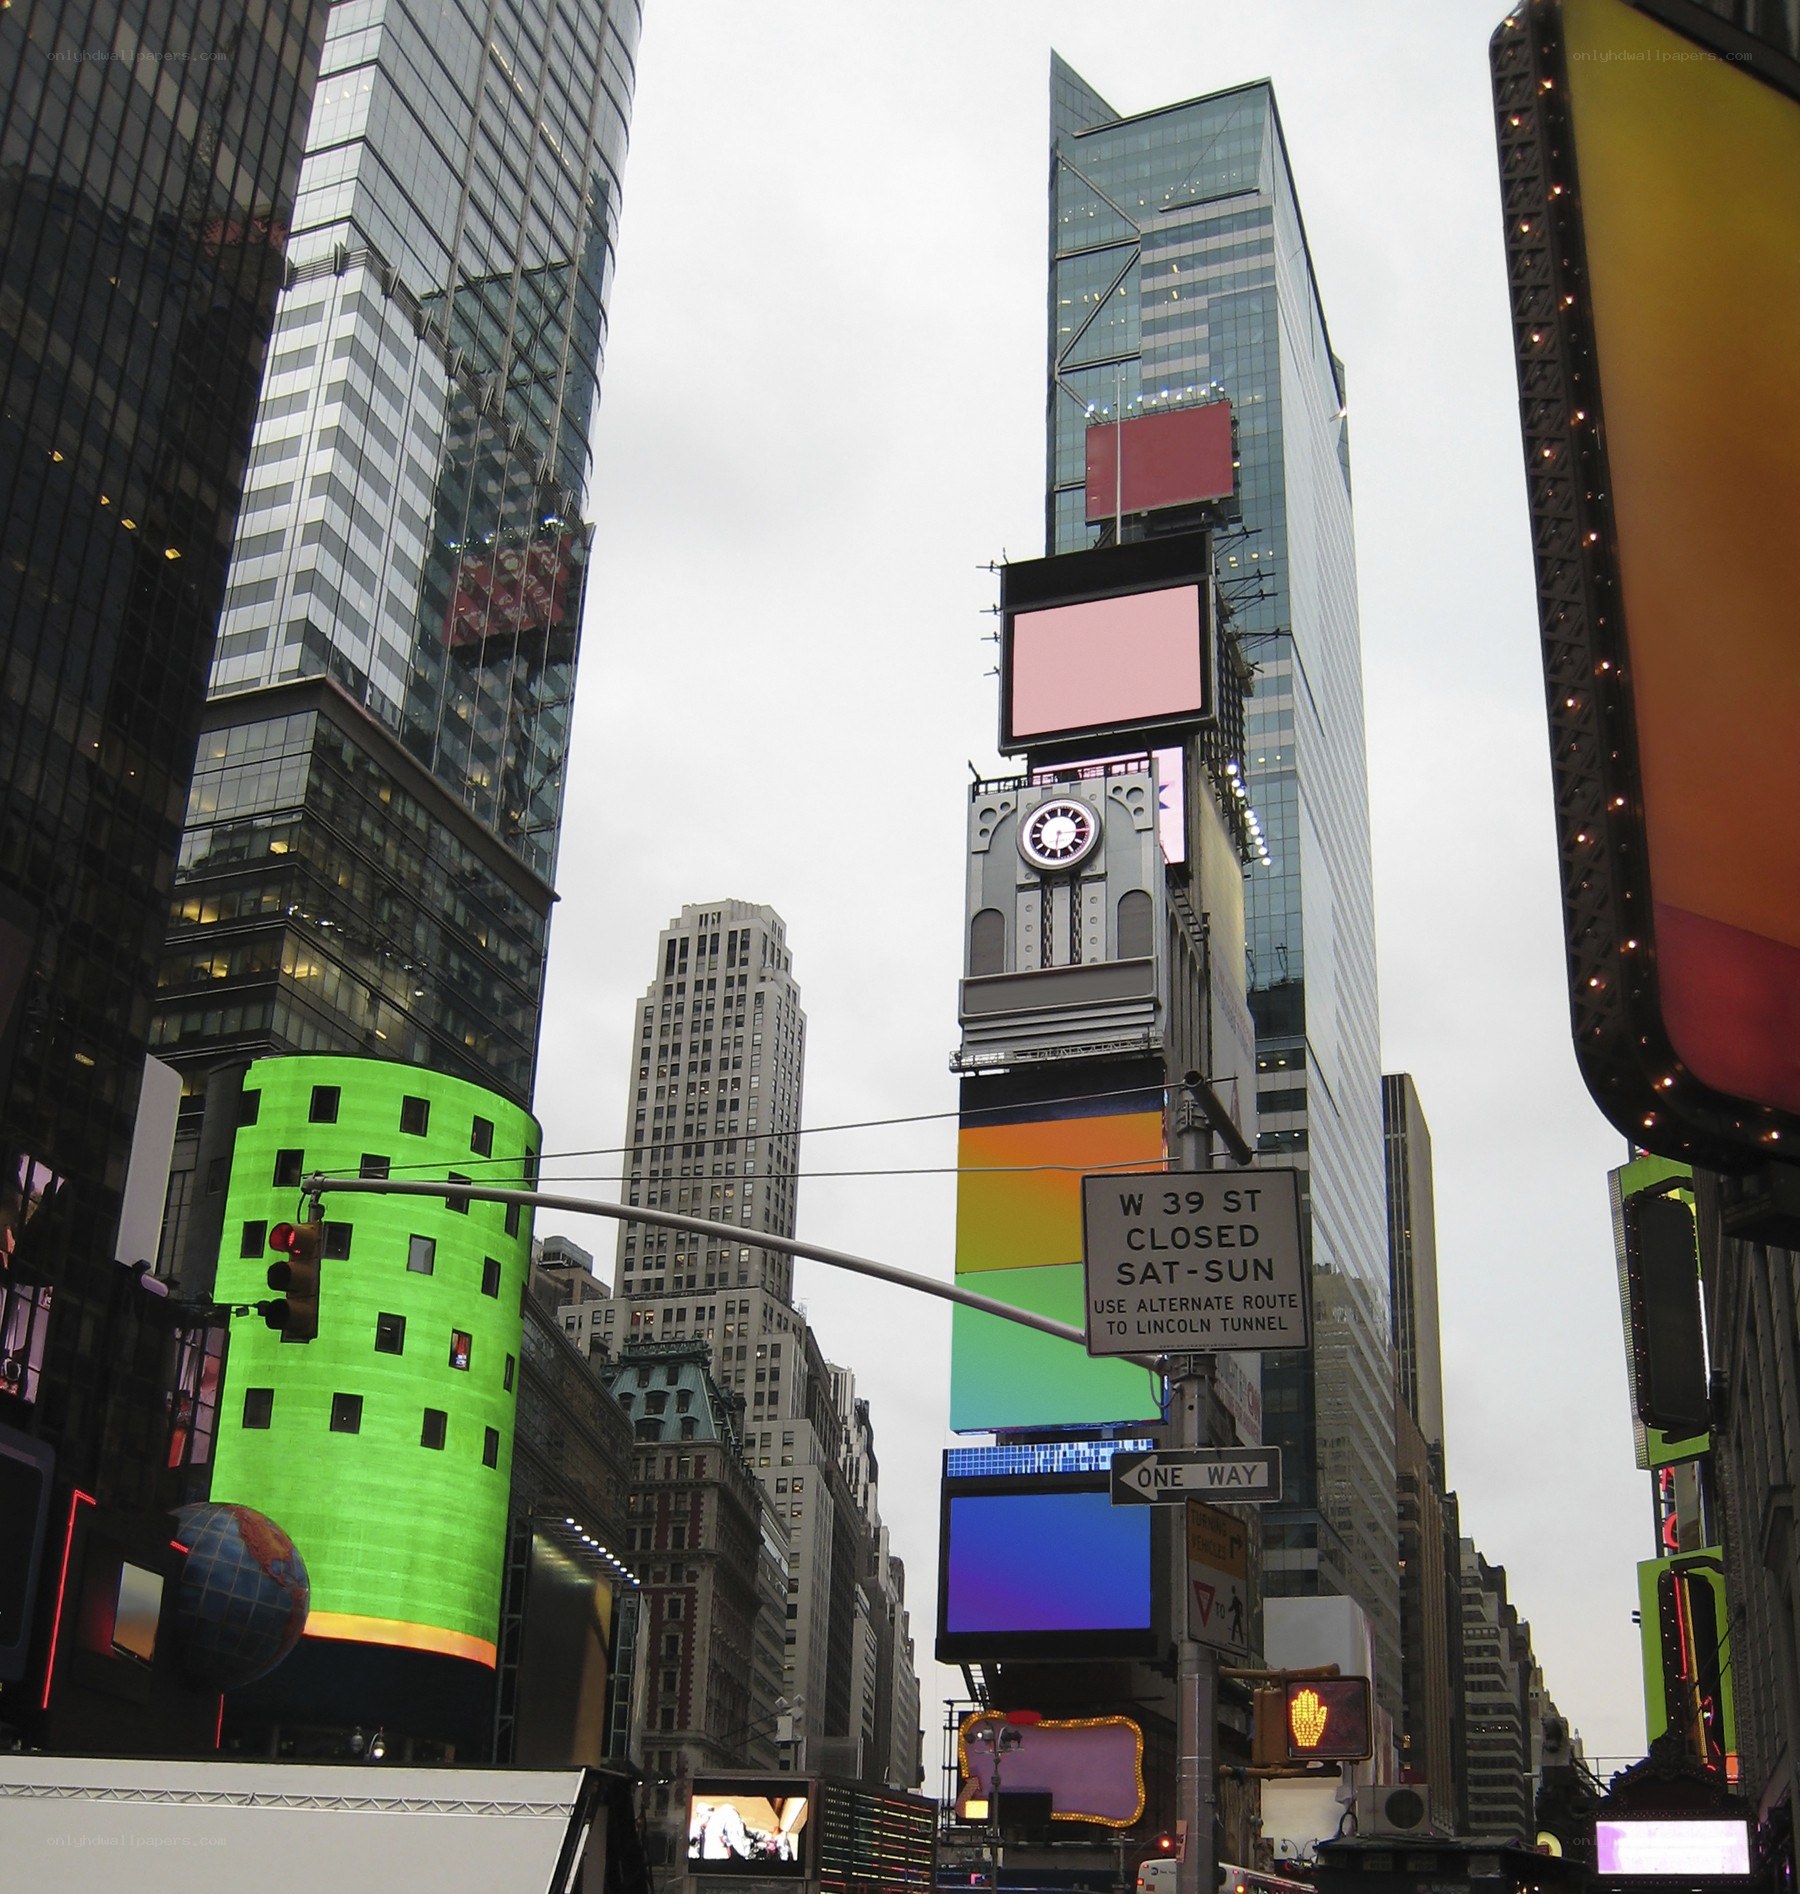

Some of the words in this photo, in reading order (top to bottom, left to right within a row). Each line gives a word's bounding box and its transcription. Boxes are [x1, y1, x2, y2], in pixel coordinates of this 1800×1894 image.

[1119, 1193, 1144, 1216] W
[1163, 1191, 1204, 1215] 39
[1223, 1189, 1262, 1213] ST
[1126, 1224, 1259, 1251] CLOSED
[1116, 1258, 1274, 1285] SAT-SUN
[1094, 1299, 1126, 1313] USE
[1137, 1296, 1234, 1313] ALTERNATE
[1243, 1293, 1298, 1310] ROUTE
[1107, 1321, 1127, 1335] TO
[1137, 1318, 1210, 1334] LINCOLN
[1221, 1316, 1288, 1332] TUNNEL
[1137, 1466, 1183, 1488] ONE
[1208, 1464, 1257, 1486] WAY
[1190, 1508, 1227, 1537] TURNING
[1190, 1533, 1227, 1561] VEHICLES
[1215, 1601, 1226, 1620] TO
